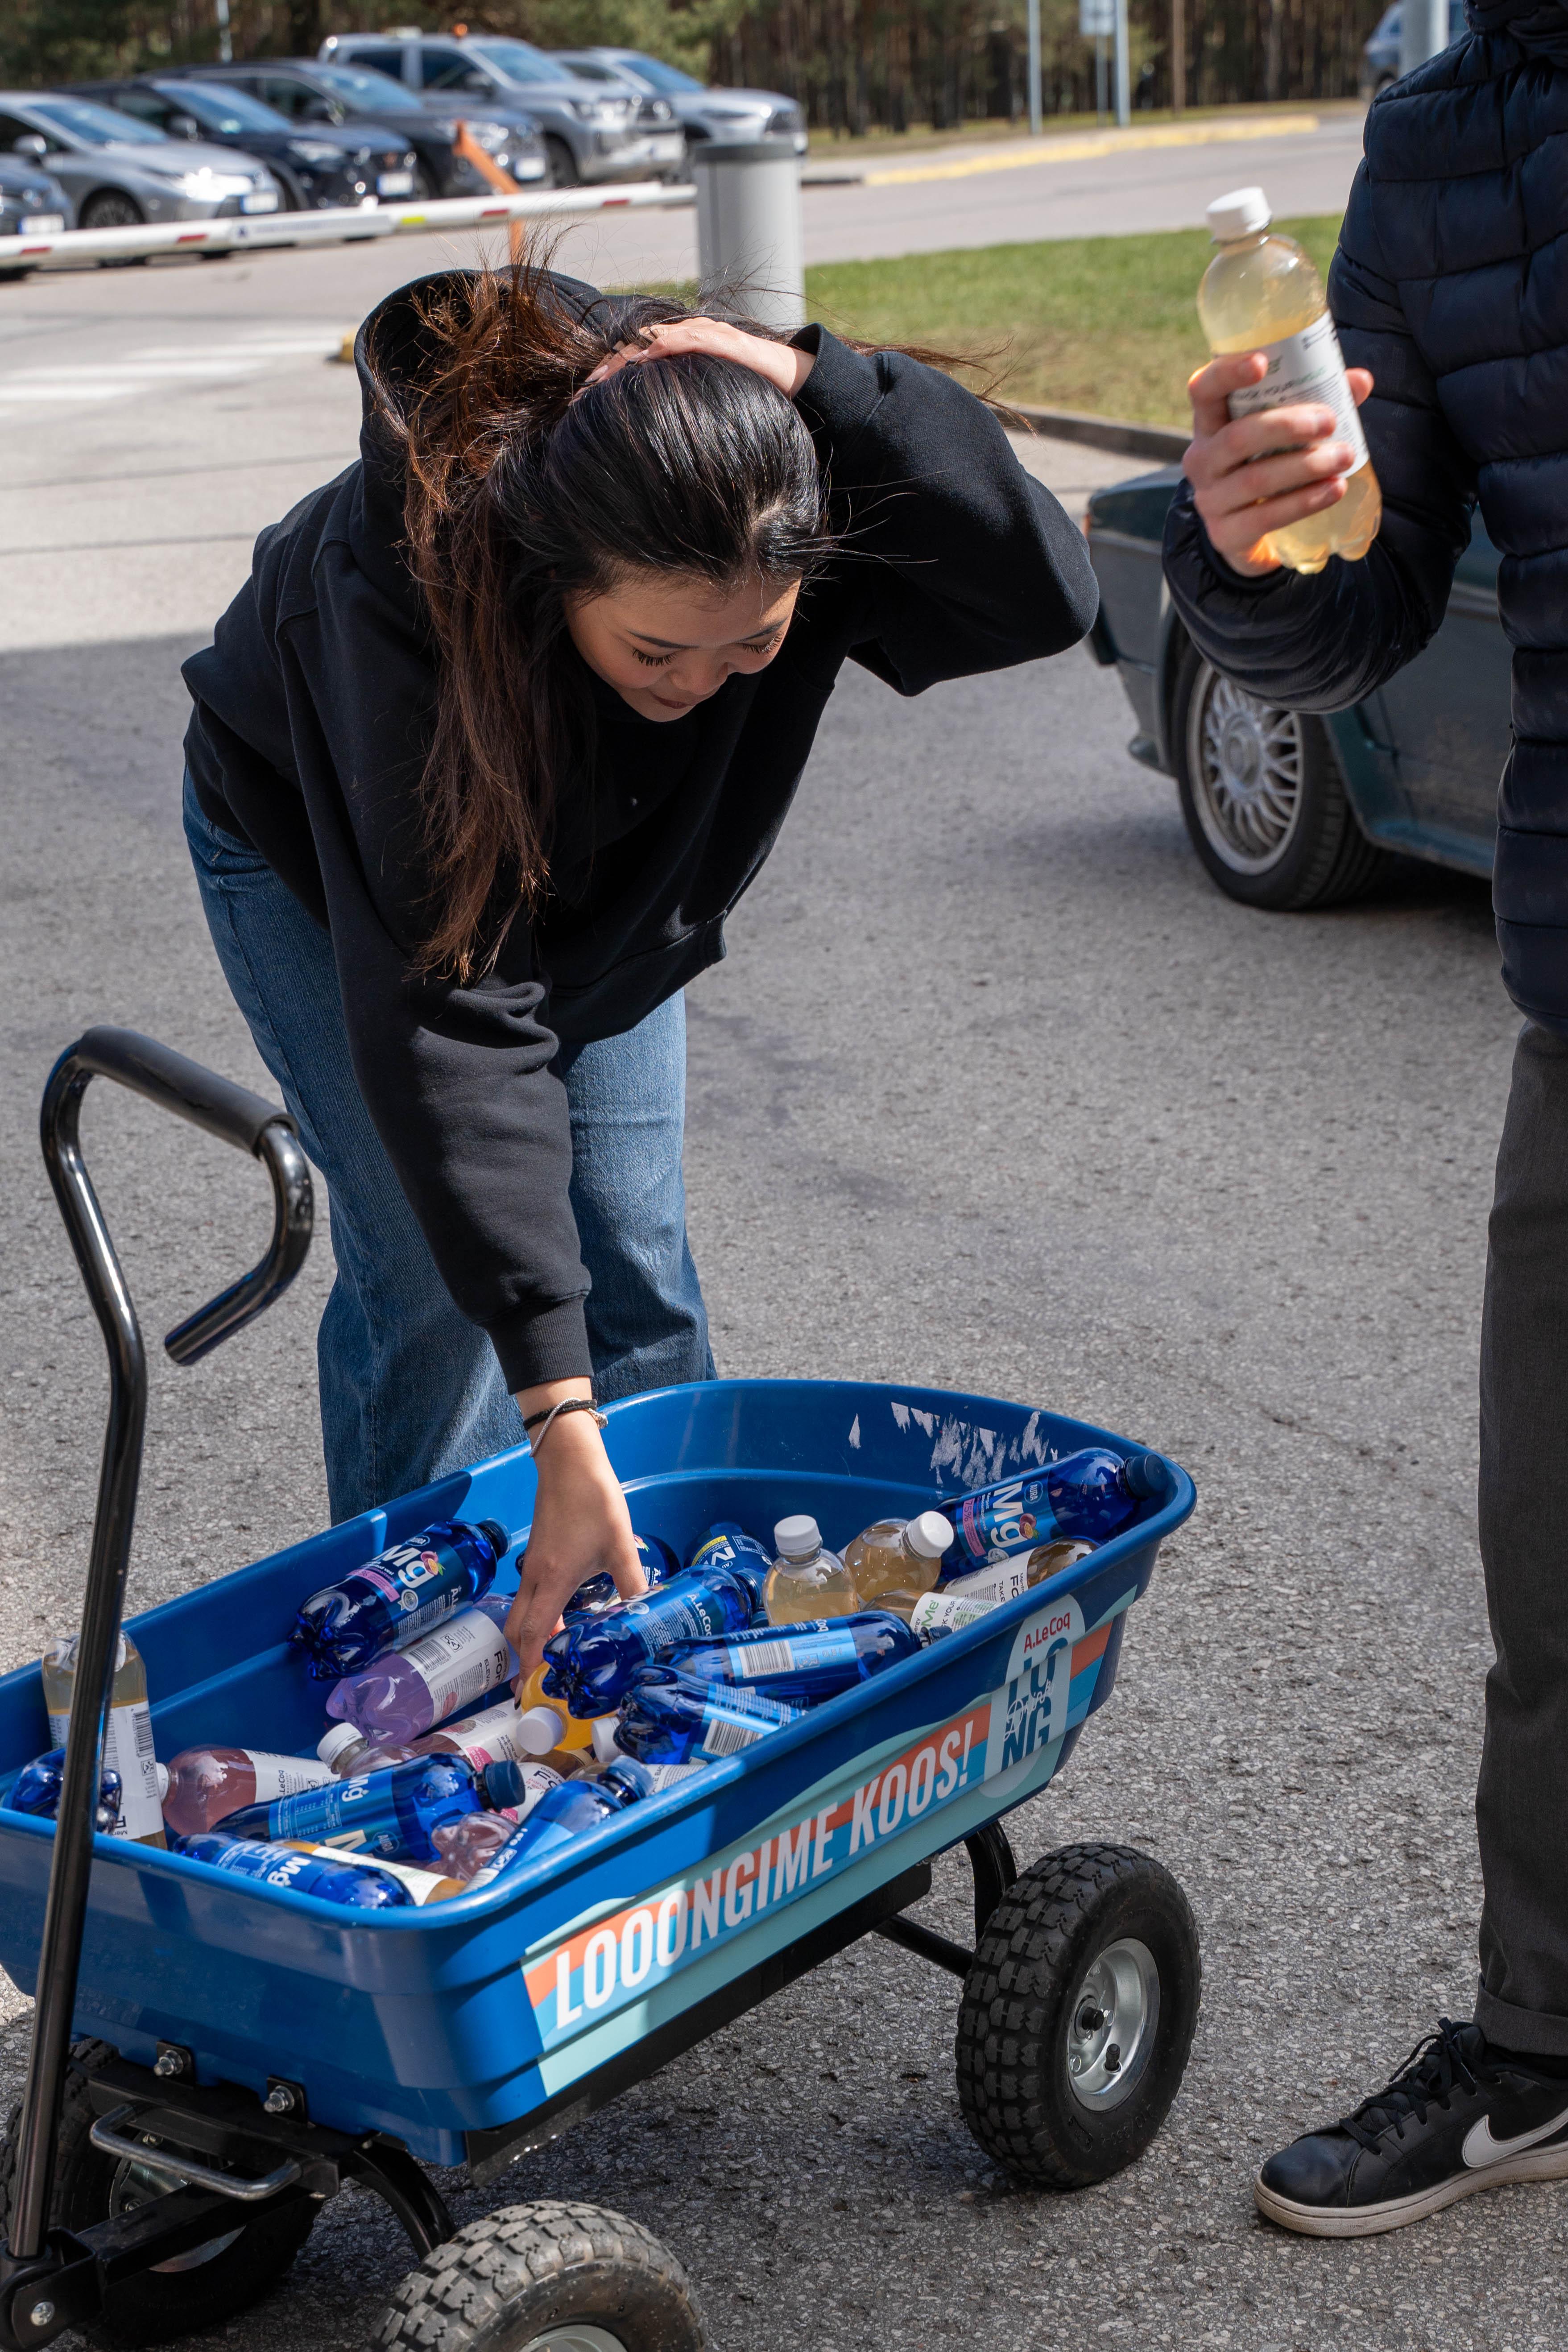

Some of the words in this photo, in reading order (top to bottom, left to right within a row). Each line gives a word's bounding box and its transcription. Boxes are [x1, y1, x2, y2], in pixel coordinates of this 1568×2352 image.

[1029, 1484, 1038, 1501] AURA
[964, 1499, 973, 1521] 75%
[990, 1481, 1028, 1548] Mg
[372, 1545, 435, 1589] Mg
[943, 1600, 956, 1618] YOUR
[1024, 1612, 1071, 1653] A.LeCoq
[342, 1772, 371, 1802] Mg
[377, 1834, 394, 1852] AURA
[268, 1856, 312, 1887] Mg
[556, 1800, 837, 2030] LOOONGIME
[848, 1720, 973, 1856] KOOS!
